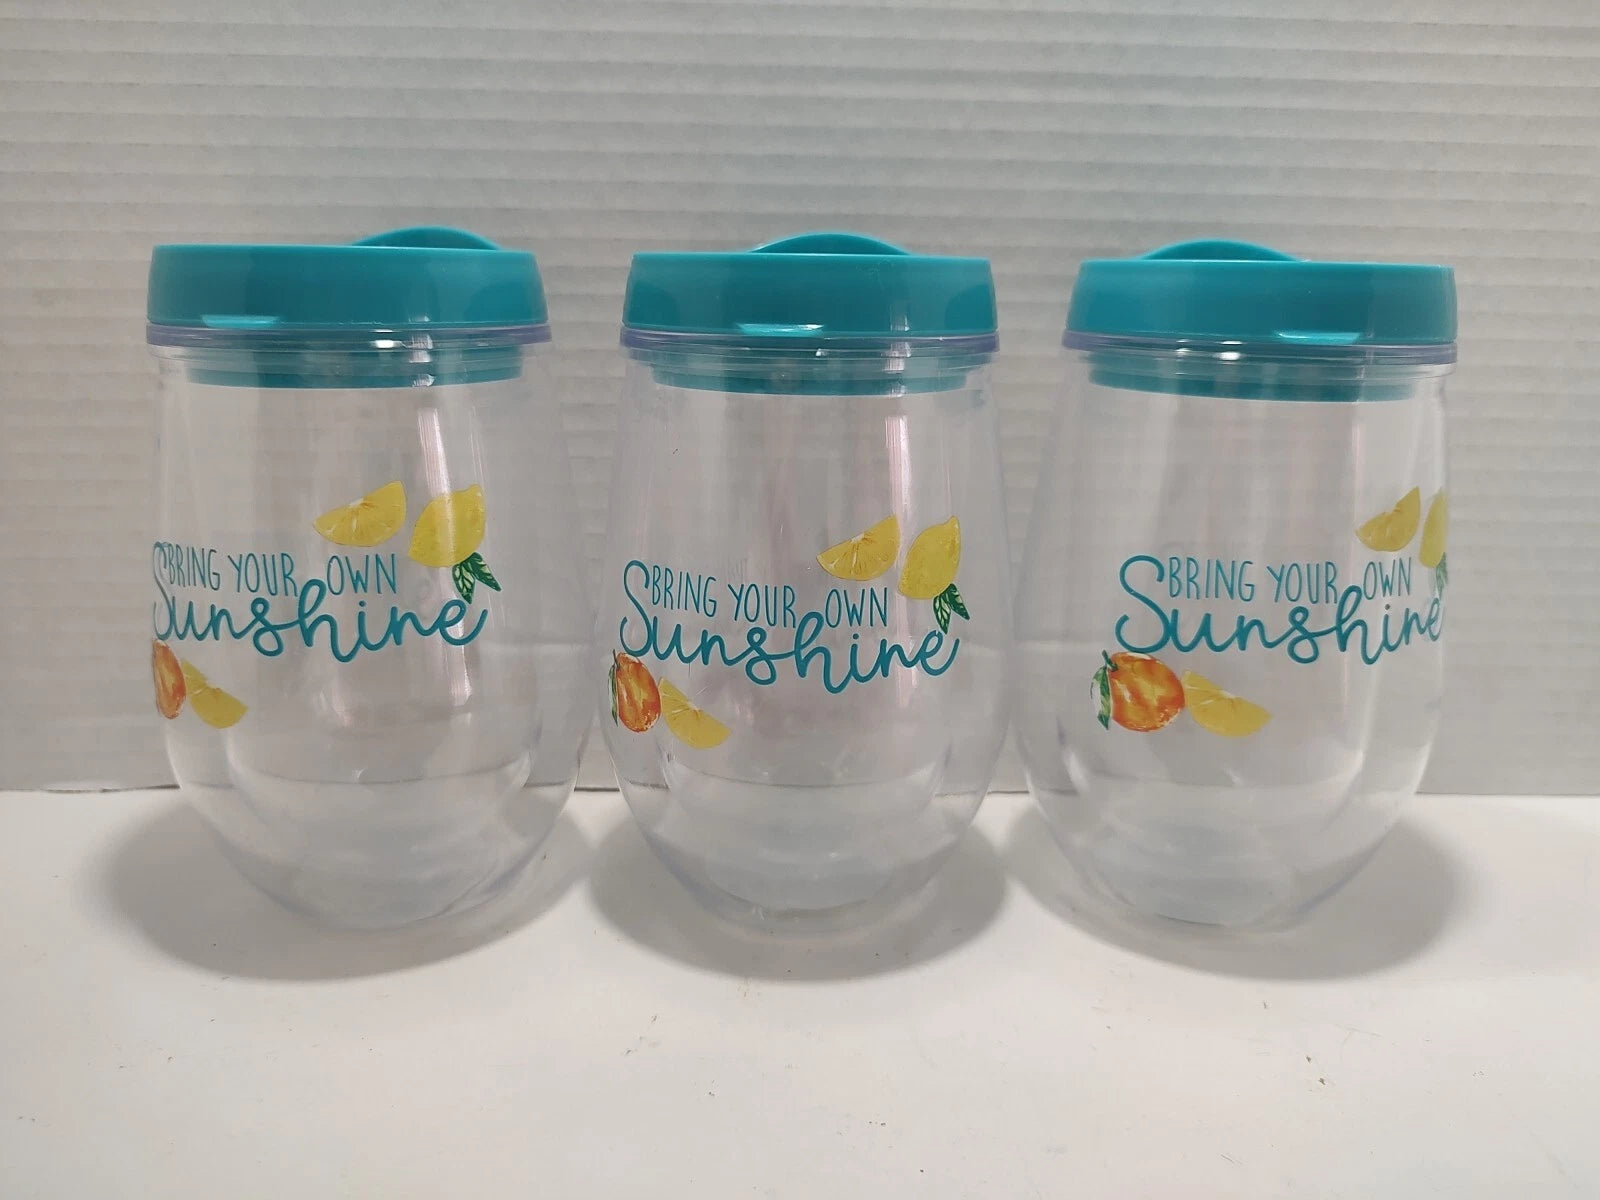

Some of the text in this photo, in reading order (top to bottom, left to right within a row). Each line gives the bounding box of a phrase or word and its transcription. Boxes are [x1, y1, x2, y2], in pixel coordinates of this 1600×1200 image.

[153, 541, 488, 663] Sunshine
[167, 542, 397, 597] BRING YOUR OWN
[652, 565, 888, 628] BRING YOUR OWN
[1115, 555, 1444, 665] Sunshine
[1168, 556, 1412, 604] BRING YOUR OWN
[620, 559, 960, 694] Sunshine
